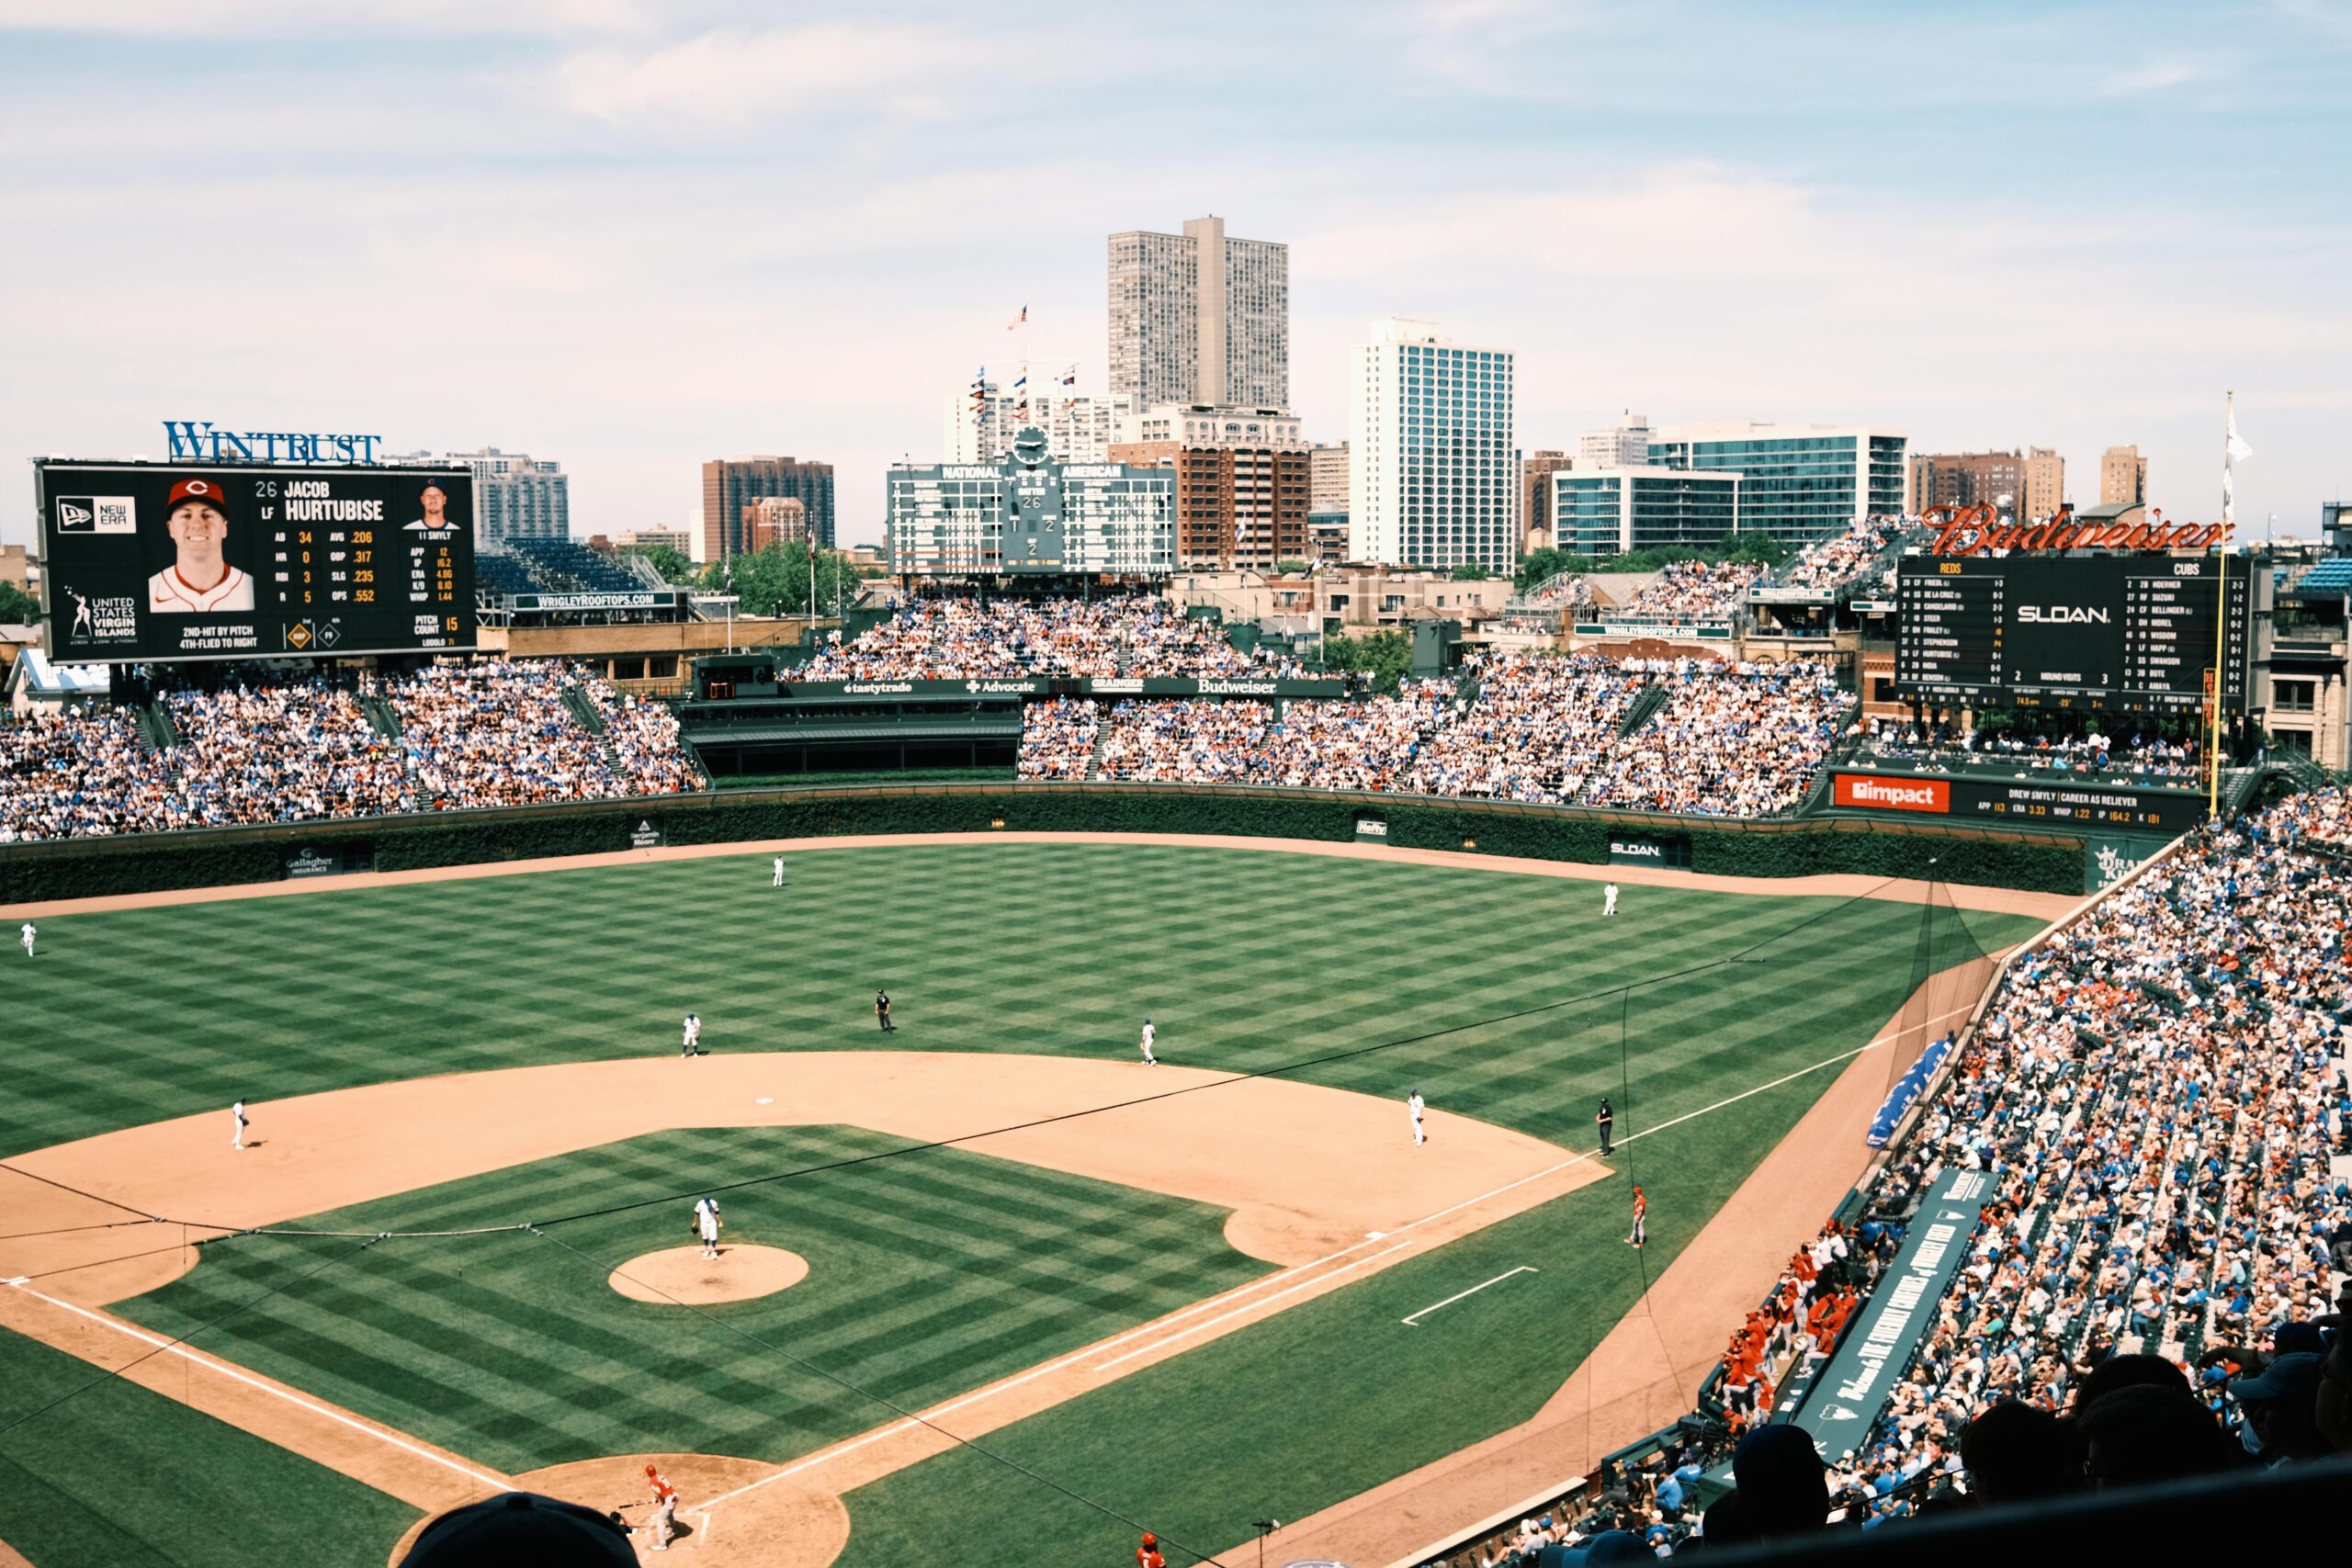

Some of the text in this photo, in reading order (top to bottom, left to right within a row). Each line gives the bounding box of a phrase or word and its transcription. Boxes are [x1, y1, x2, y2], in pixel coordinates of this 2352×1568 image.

[162, 421, 381, 463] WINTRUST
[943, 467, 1001, 479] NATIONAL
[1062, 465, 1121, 478] AMERICAN
[255, 481, 277, 498] 26
[284, 480, 330, 498] JACOB
[1023, 497, 1041, 509] 26
[100, 505, 126, 514] NEW
[261, 507, 275, 520] LF
[285, 500, 384, 521] HURTUBISE
[101, 515, 127, 525] ERA
[1921, 503, 2235, 556] Budweiser
[275, 531, 312, 544] AB 34
[330, 531, 373, 544] AVG .206
[427, 532, 451, 540] SMYLY
[275, 552, 288, 562] HR
[330, 550, 371, 563] OBP .317
[410, 547, 447, 557] APP 12
[413, 558, 451, 568] IP 16.2
[1939, 562, 1962, 574] REDS
[411, 570, 425, 579] ERA
[2174, 563, 2199, 576] CUBS
[275, 572, 288, 582] RBI
[331, 570, 374, 582] SLG .235
[332, 590, 375, 602] OPS .552
[410, 592, 453, 602] WHIP 1.44
[537, 593, 655, 607] WRIGLEYROOFTOPS.COM
[2152, 593, 2175, 602] SUZUKI
[92, 597, 134, 607] UNITED
[93, 607, 135, 618] STATES
[2018, 606, 2108, 624] SLOAN
[2152, 606, 2185, 615] BELLINGER
[94, 618, 136, 628] VIRGIN
[415, 615, 438, 625] PITCH
[447, 616, 458, 631] 15
[2151, 619, 2172, 627] MOREL
[95, 627, 136, 637] ISLANDS
[183, 626, 253, 637] 2ND-HIT BY PITCH
[414, 625, 440, 635] COUNT
[2151, 631, 2177, 640] WISDOM
[179, 637, 257, 649] 4TH-FLIED TO RIGHT
[2138, 644, 2146, 652] LF
[2150, 644, 2167, 652] HAPP
[2150, 657, 2181, 666] SWANSON
[2041, 671, 2063, 681] MOUND
[2063, 672, 2081, 682] VISITS
[853, 682, 912, 694] tastytrade
[982, 682, 1035, 693] Advocate
[1091, 679, 1144, 688] GRAINGER
[1197, 679, 1276, 694] Budweiser
[2149, 682, 2171, 691] AMAYA
[1868, 780, 1934, 806] impact
[2009, 789, 2138, 807] DREW SMYLY CAREER AS RELIEVER
[1978, 801, 1991, 811] APP
[1995, 803, 2006, 812] 113
[2013, 804, 2026, 813] ERA
[2029, 806, 2046, 816] 3.33
[2053, 807, 2072, 817] WHIP
[2075, 808, 2090, 819] 1.22
[2098, 810, 2106, 818] IP
[1611, 842, 1659, 857] SLOAN
[286, 857, 333, 868] Gallagher
